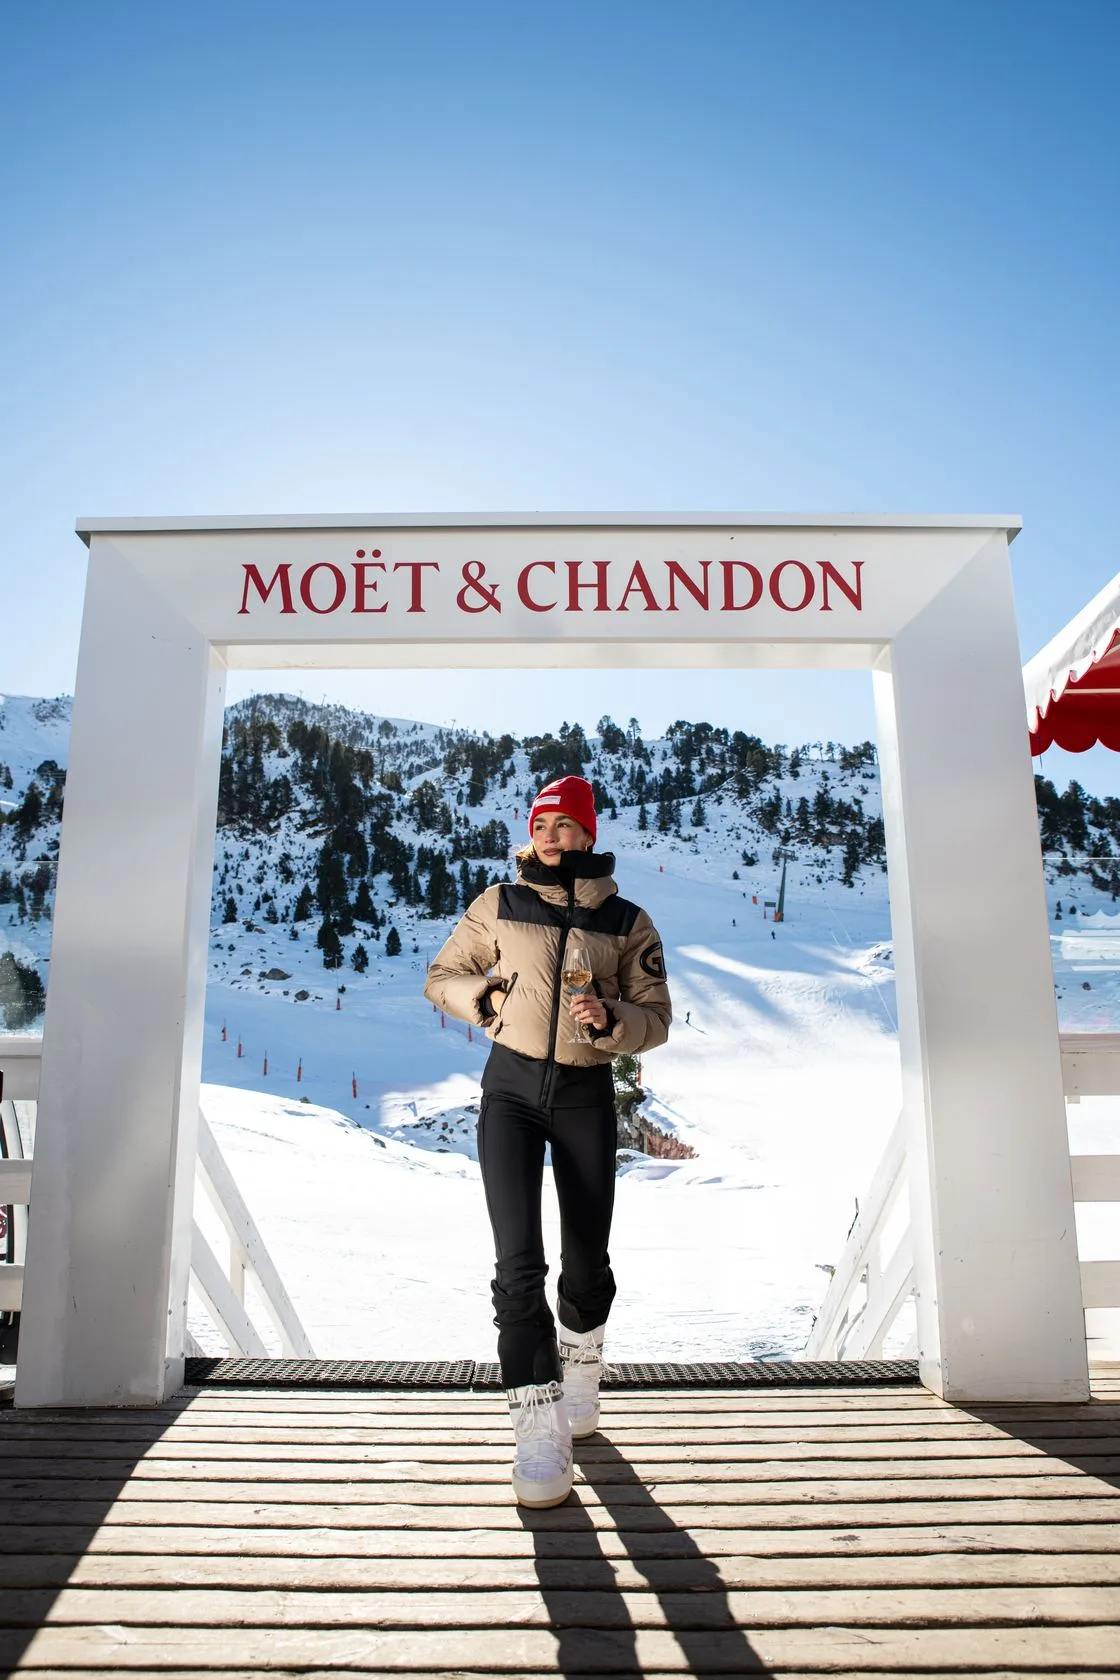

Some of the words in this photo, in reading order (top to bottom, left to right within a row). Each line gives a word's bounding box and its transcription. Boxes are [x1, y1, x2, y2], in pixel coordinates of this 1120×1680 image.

[238, 549, 440, 615] MOËT
[456, 561, 502, 614] &
[517, 559, 865, 613] CHANDON
